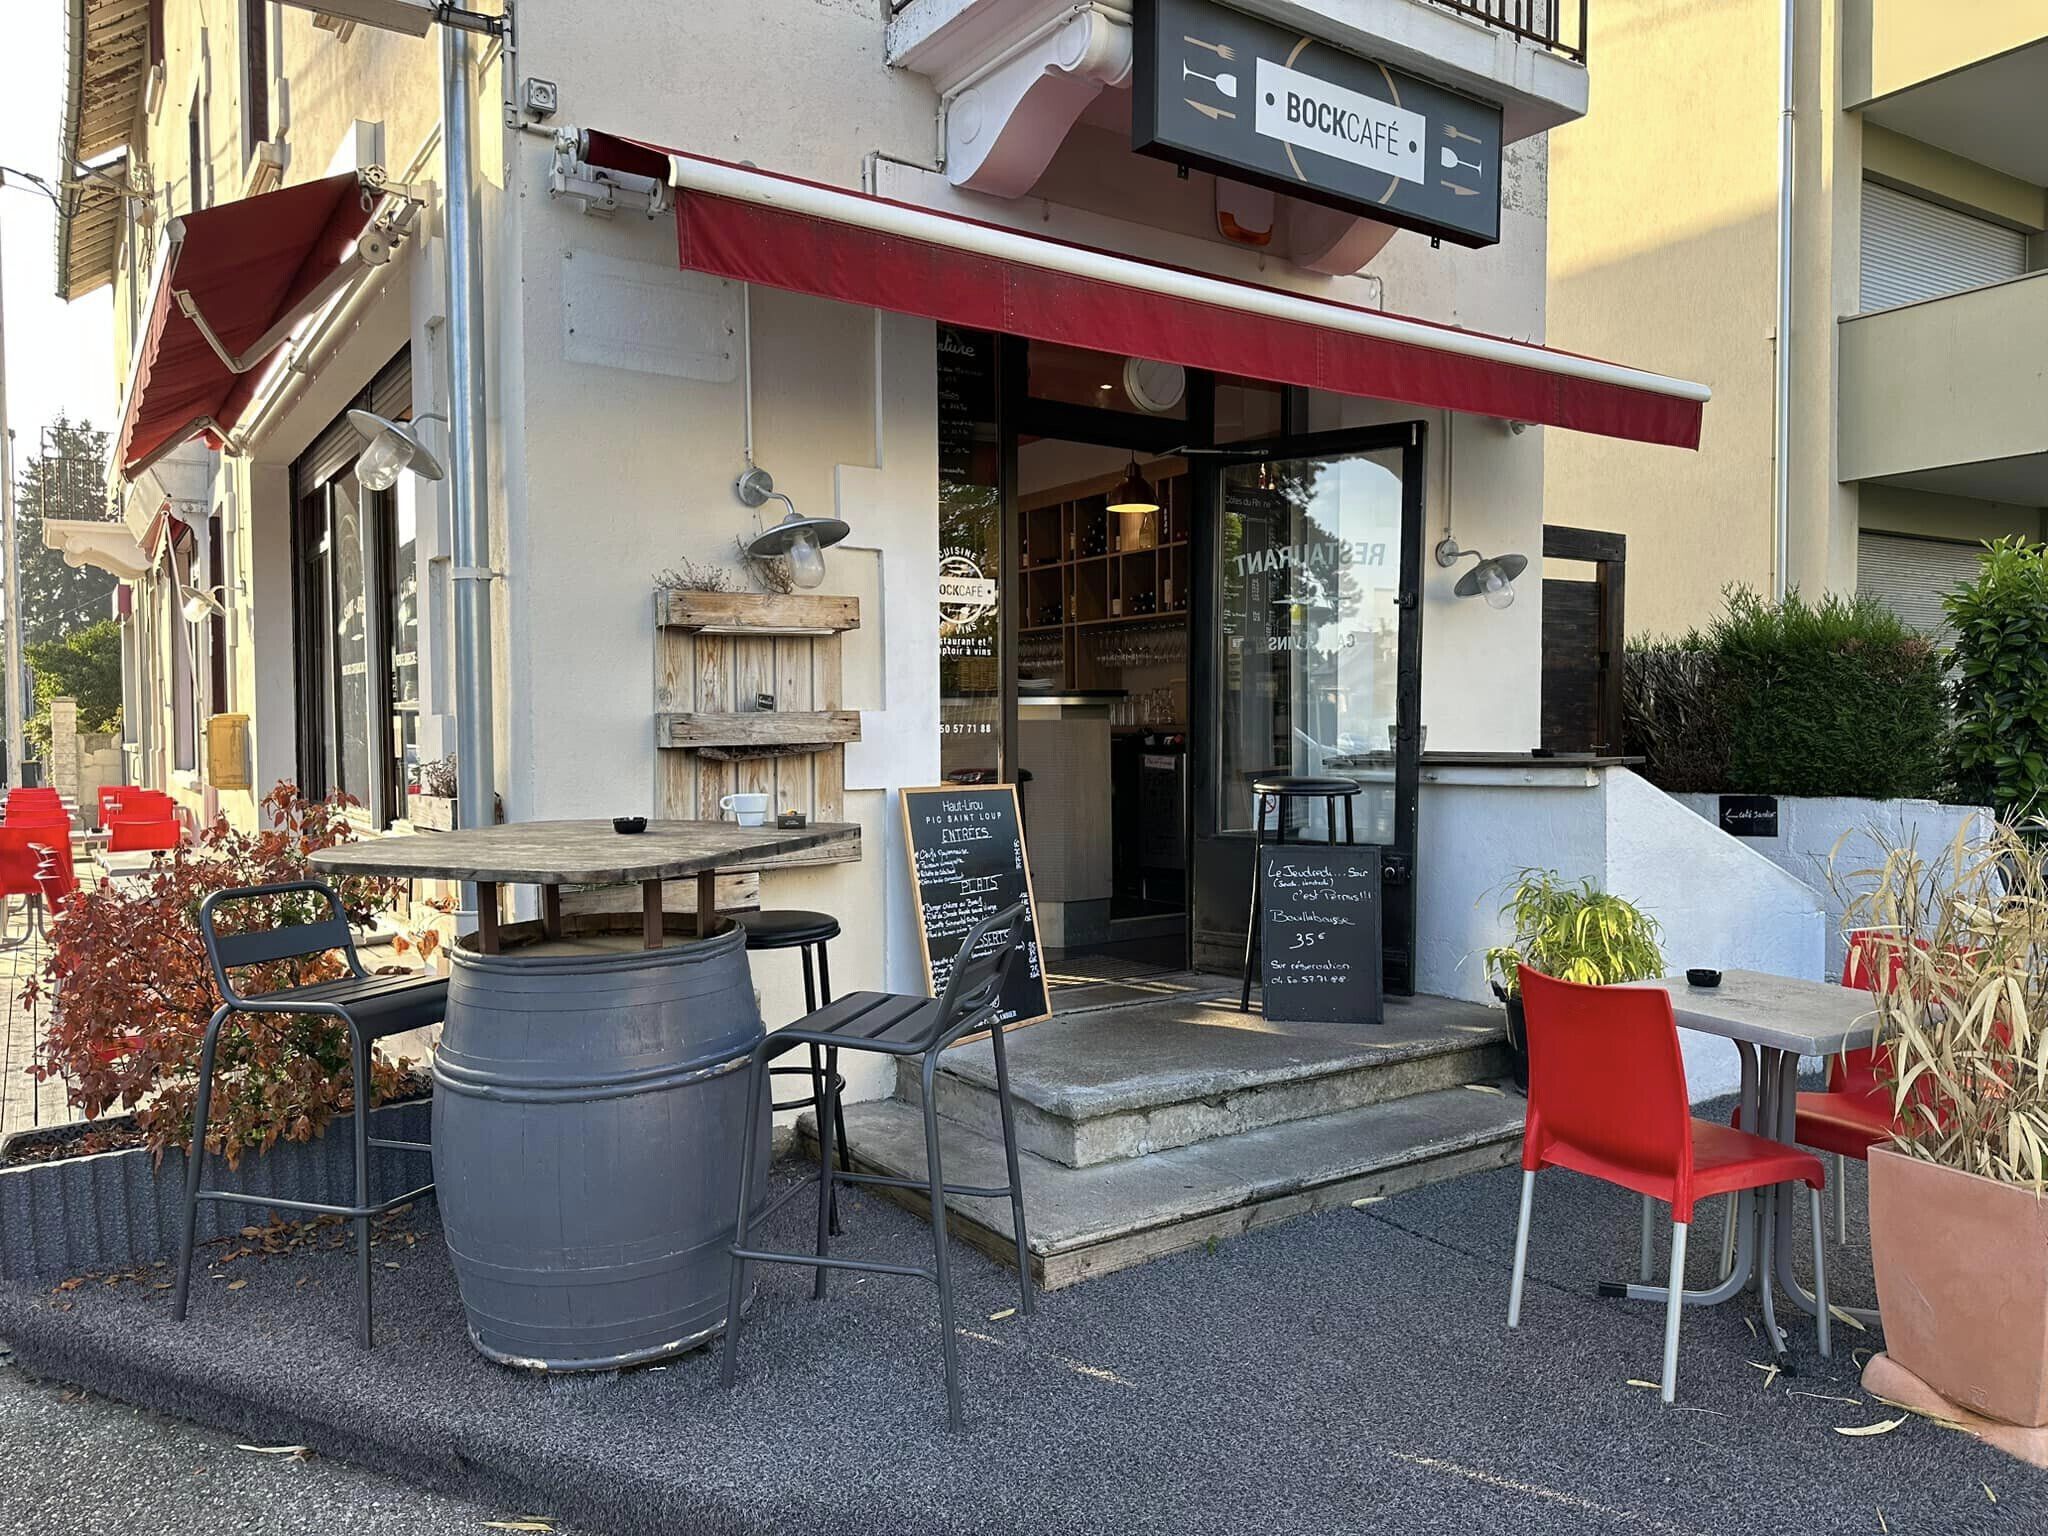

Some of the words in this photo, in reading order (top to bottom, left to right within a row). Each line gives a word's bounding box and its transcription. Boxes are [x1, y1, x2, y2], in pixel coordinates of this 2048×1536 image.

[1287, 91, 1399, 156] BOCKCAFÉ
[939, 584, 983, 598] OCKCAFÉ
[939, 637, 975, 647] staurant
[977, 638, 987, 647] et
[974, 647, 992, 657] vins
[953, 724, 965, 734] 57
[967, 724, 977, 734] 71
[980, 724, 992, 734] 88
[942, 800, 984, 812] Haut-Lirou
[926, 815, 942, 824] PIC
[947, 813, 975, 823] SAINT
[979, 811, 1002, 821] LOUP
[941, 824, 993, 844] ENTRÉES
[1347, 867, 1369, 878] Soir
[960, 876, 999, 895] PLATS
[1270, 959, 1287, 969] Sur
